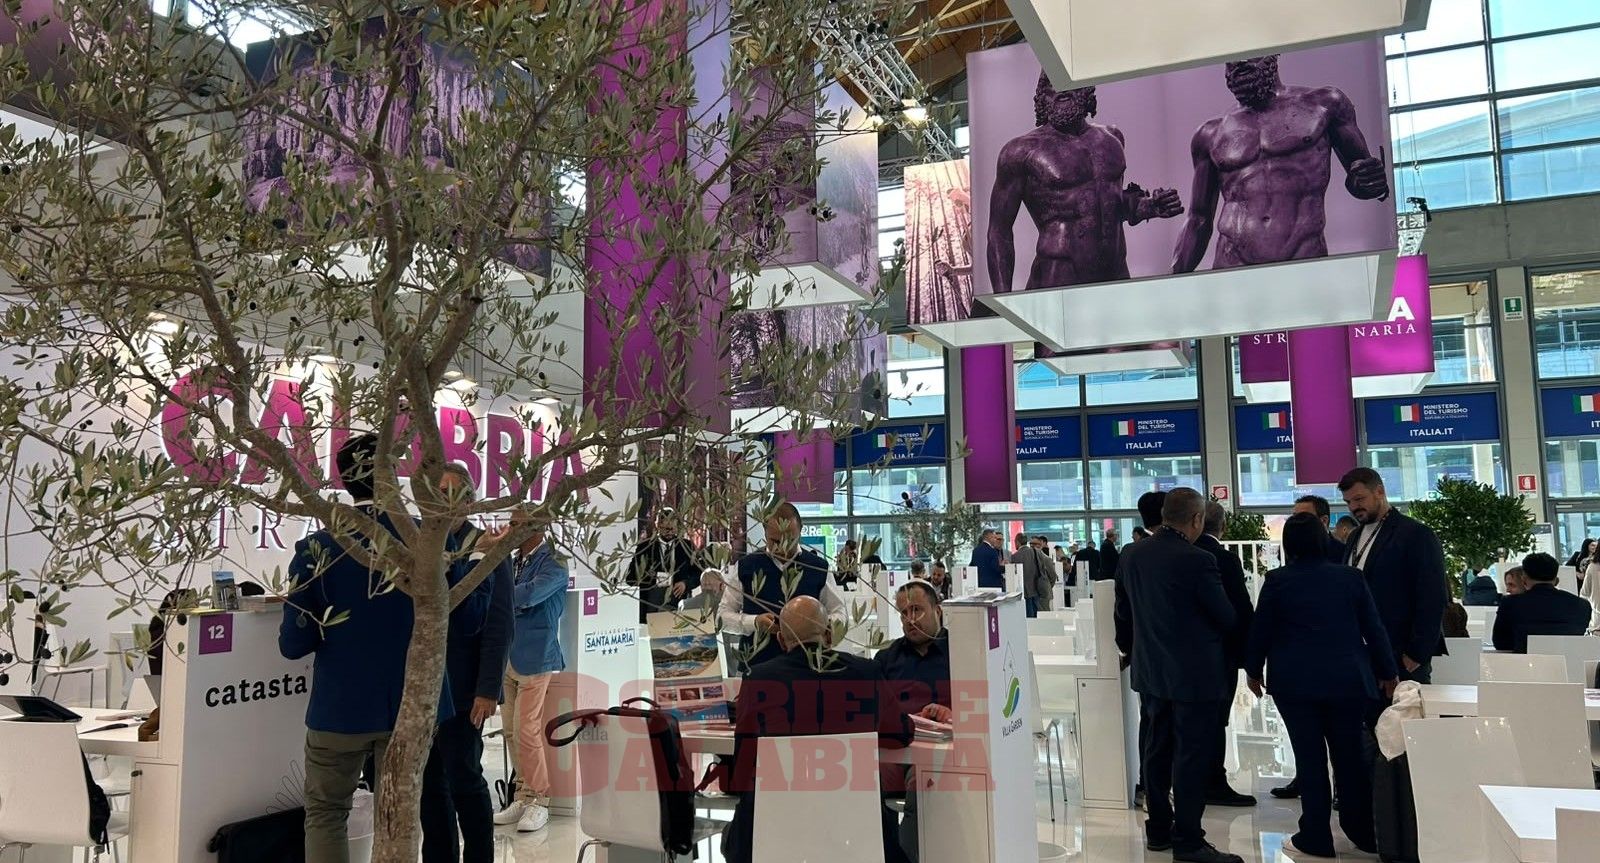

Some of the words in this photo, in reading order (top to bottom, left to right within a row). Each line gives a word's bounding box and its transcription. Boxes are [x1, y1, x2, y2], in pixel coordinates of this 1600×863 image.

[1409, 427, 1454, 437] ITALIA.IT
[1016, 446, 1048, 455] TALIA.IT
[1125, 441, 1163, 450] ITALIA.IT
[587, 596, 595, 606] 13
[991, 617, 996, 633] 6
[208, 624, 225, 639] 12
[586, 635, 610, 648] SANTA
[611, 633, 634, 646] MARIA
[205, 673, 307, 707] catasta
